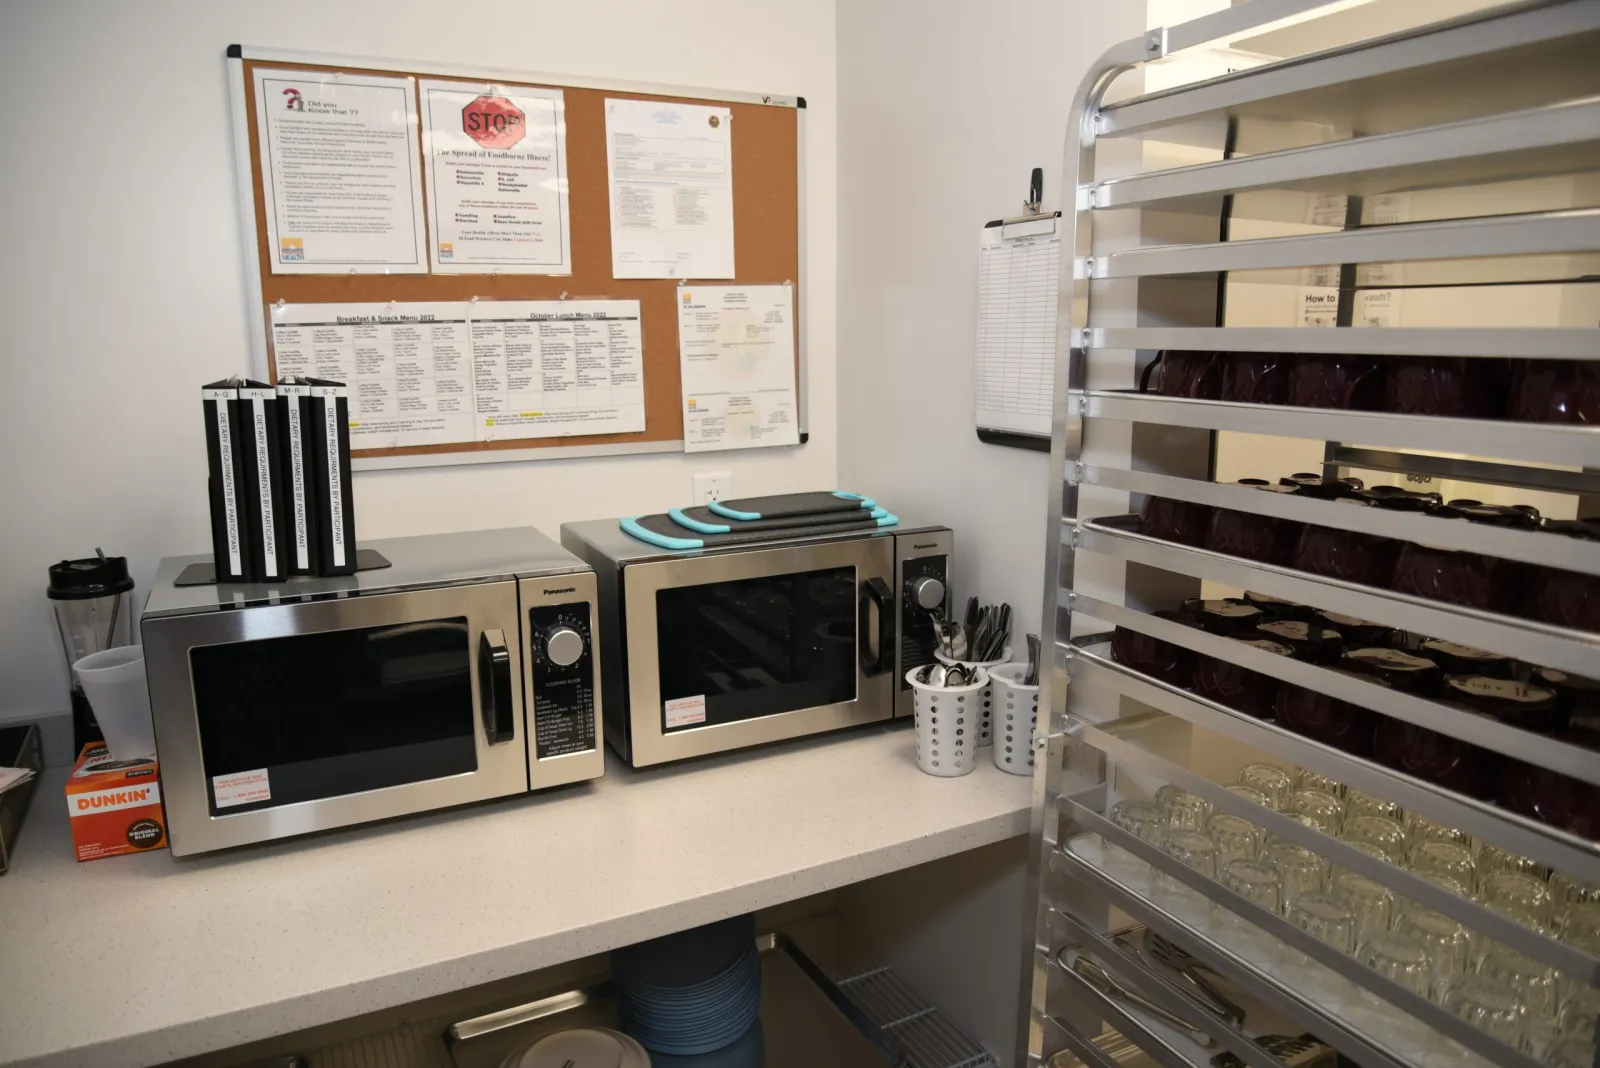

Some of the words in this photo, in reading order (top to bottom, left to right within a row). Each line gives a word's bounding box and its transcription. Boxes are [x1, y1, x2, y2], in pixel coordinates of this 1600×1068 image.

[468, 112, 521, 133] STOP
[452, 150, 476, 159] Spread
[488, 152, 526, 161] Foodborne
[526, 154, 551, 162] Illness!
[1305, 294, 1324, 302] How
[220, 412, 228, 444] DIETARY
[256, 414, 264, 444] DIETARY
[290, 409, 298, 440] DIETARY
[1406, 474, 1432, 484] GOJO
[296, 492, 302, 501] BY
[332, 490, 339, 499] BY
[227, 498, 234, 507] BY
[263, 500, 270, 508] BY
[296, 504, 305, 548] PARTICIPANT
[333, 502, 342, 545] PARTICIPANT
[228, 508, 238, 554] PARTICIPANT
[264, 510, 273, 555] PARTICIPANT
[913, 542, 938, 550] Panasonic
[543, 586, 576, 596] Panasonic
[78, 788, 150, 810] DUNKIN'
[128, 828, 160, 837] ORIGINAL
